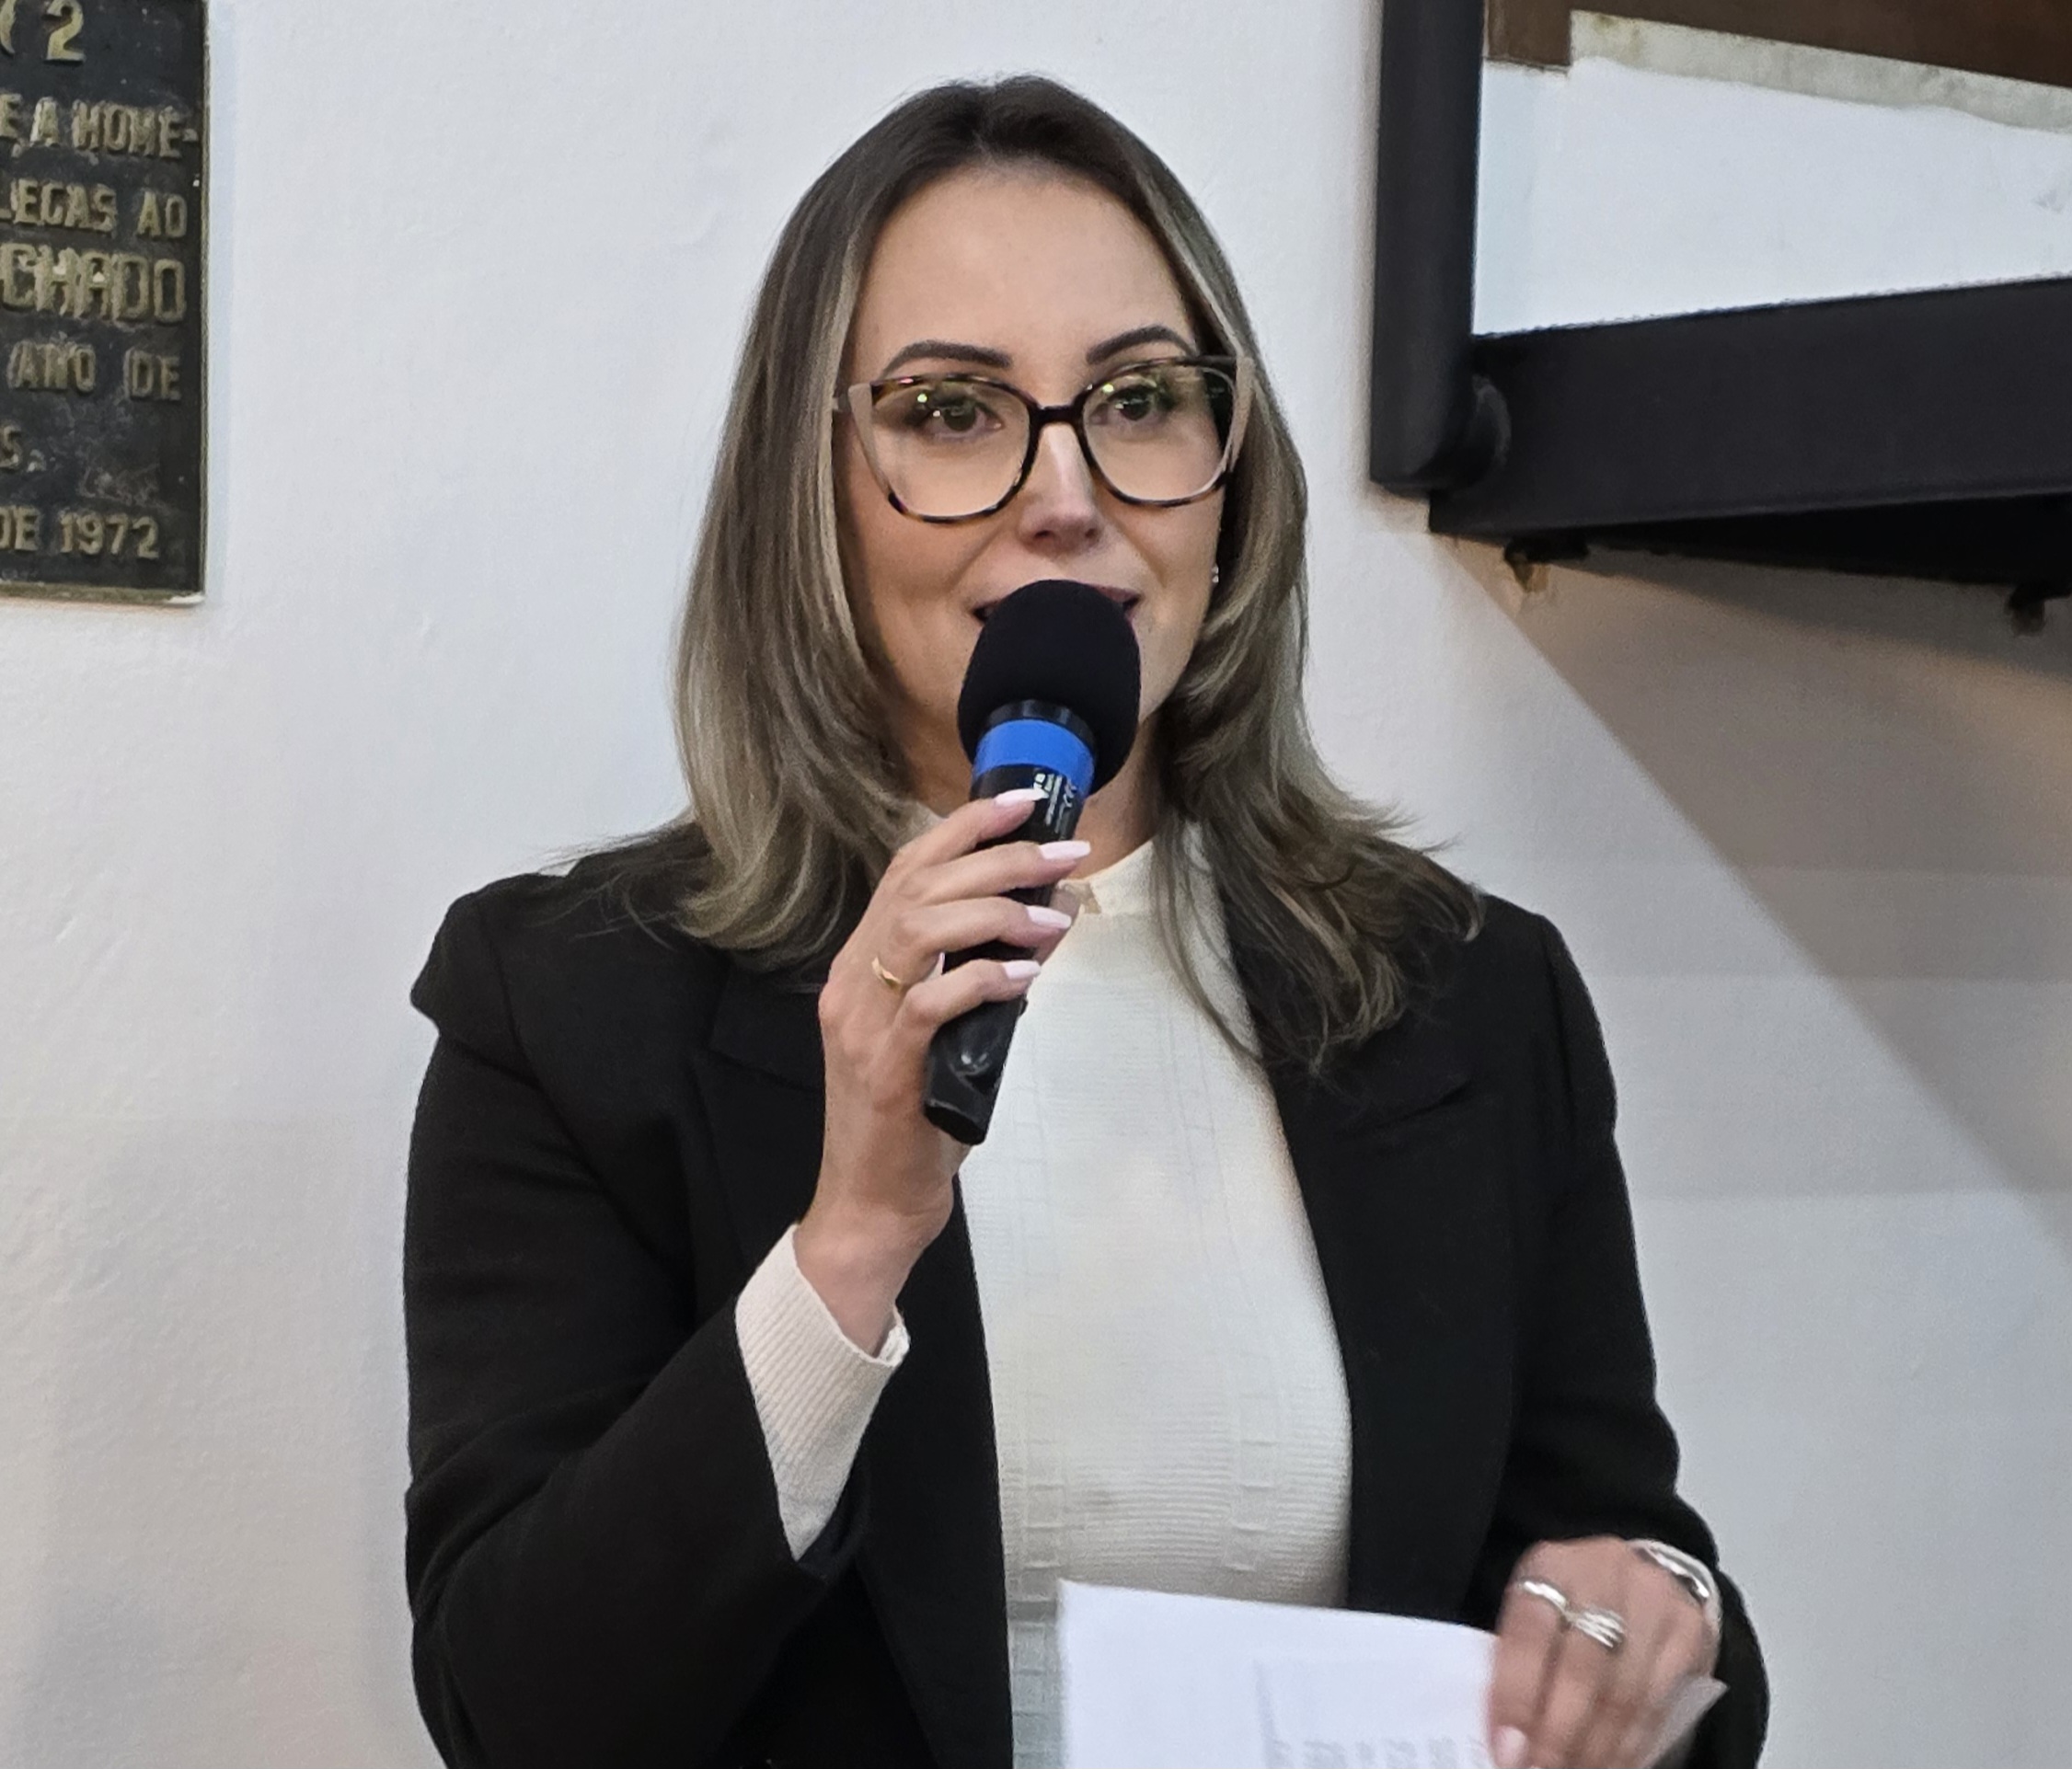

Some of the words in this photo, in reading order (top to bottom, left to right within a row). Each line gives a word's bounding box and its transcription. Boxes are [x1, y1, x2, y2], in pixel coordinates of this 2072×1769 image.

[30, 97, 59, 147] A
[139, 189, 187, 237] AO
[0, 243, 186, 321] CHADO
[124, 347, 181, 399] DE
[59, 509, 159, 559] 1972
